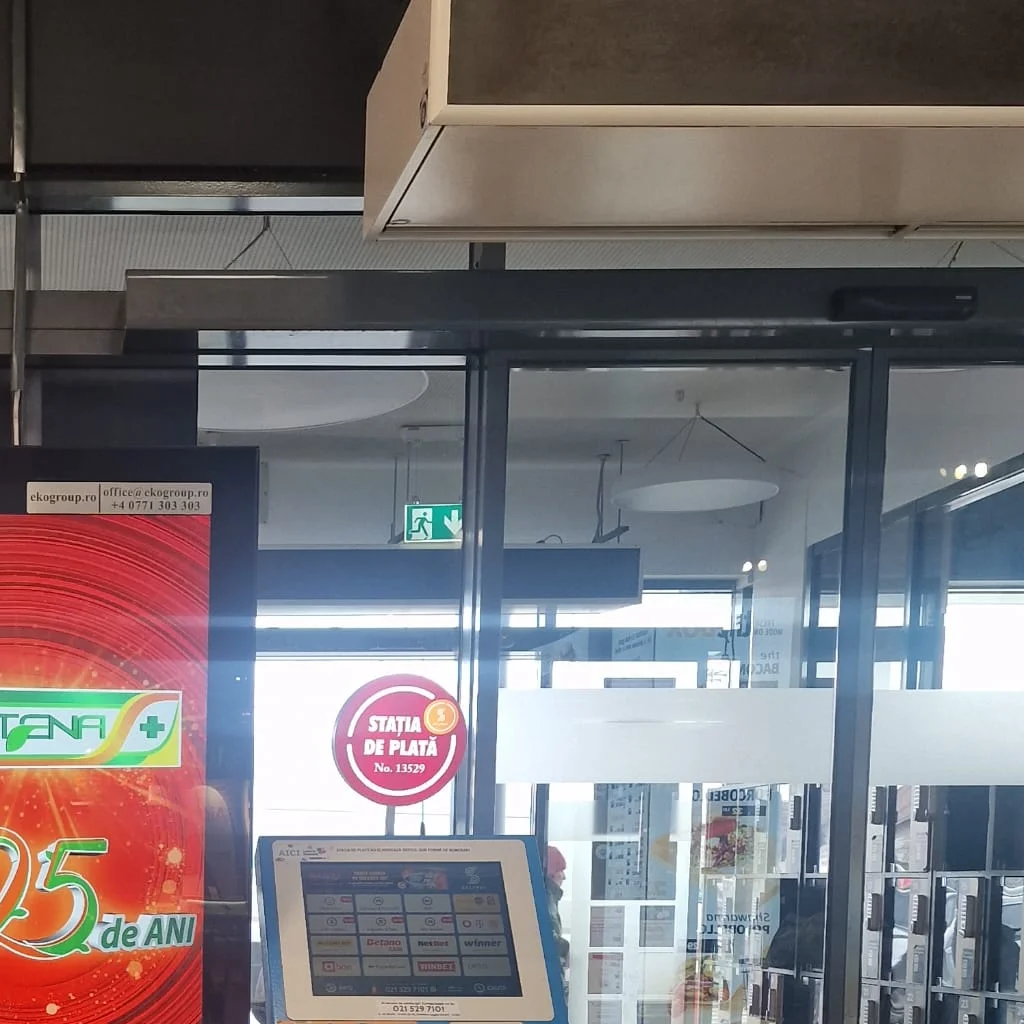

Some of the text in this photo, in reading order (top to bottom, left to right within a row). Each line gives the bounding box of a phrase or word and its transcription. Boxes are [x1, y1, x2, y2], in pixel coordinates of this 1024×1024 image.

[30, 493, 97, 505] ekogroup.ro
[103, 487, 209, 499] office@ekogroup.ro
[128, 501, 154, 511] 0771
[158, 501, 177, 511] 303
[181, 501, 200, 511] 303
[363, 736, 438, 757] DE PLATĂ
[374, 763, 425, 774] No. 13529
[101, 915, 195, 949] de ANI
